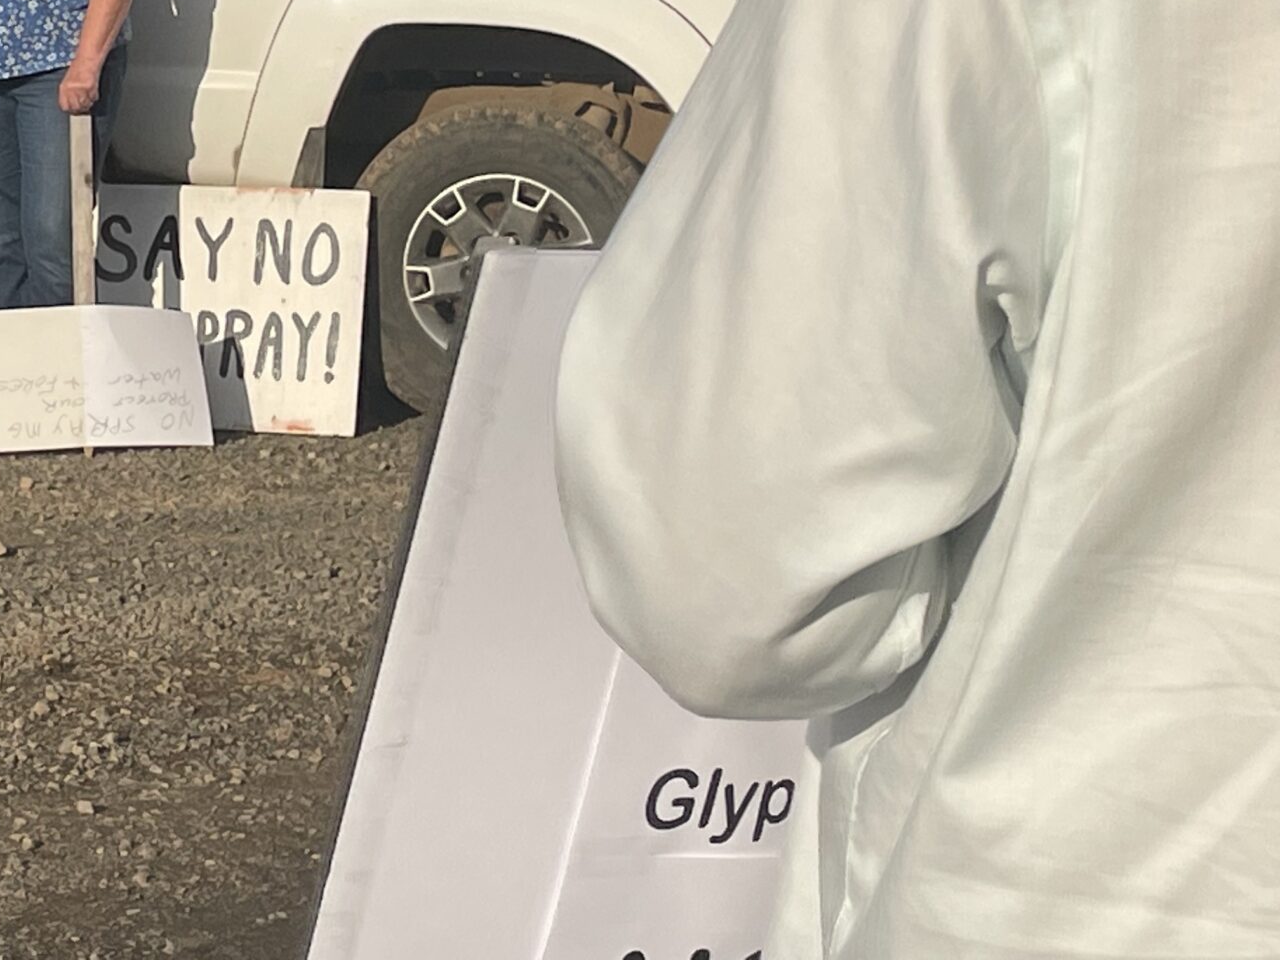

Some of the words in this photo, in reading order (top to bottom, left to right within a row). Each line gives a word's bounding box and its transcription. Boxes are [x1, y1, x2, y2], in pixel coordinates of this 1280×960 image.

[96, 213, 234, 282] SAY
[253, 217, 342, 286] NO
[196, 308, 342, 385] PRAY!
[160, 404, 194, 430] NO
[645, 768, 796, 844] Glyp
